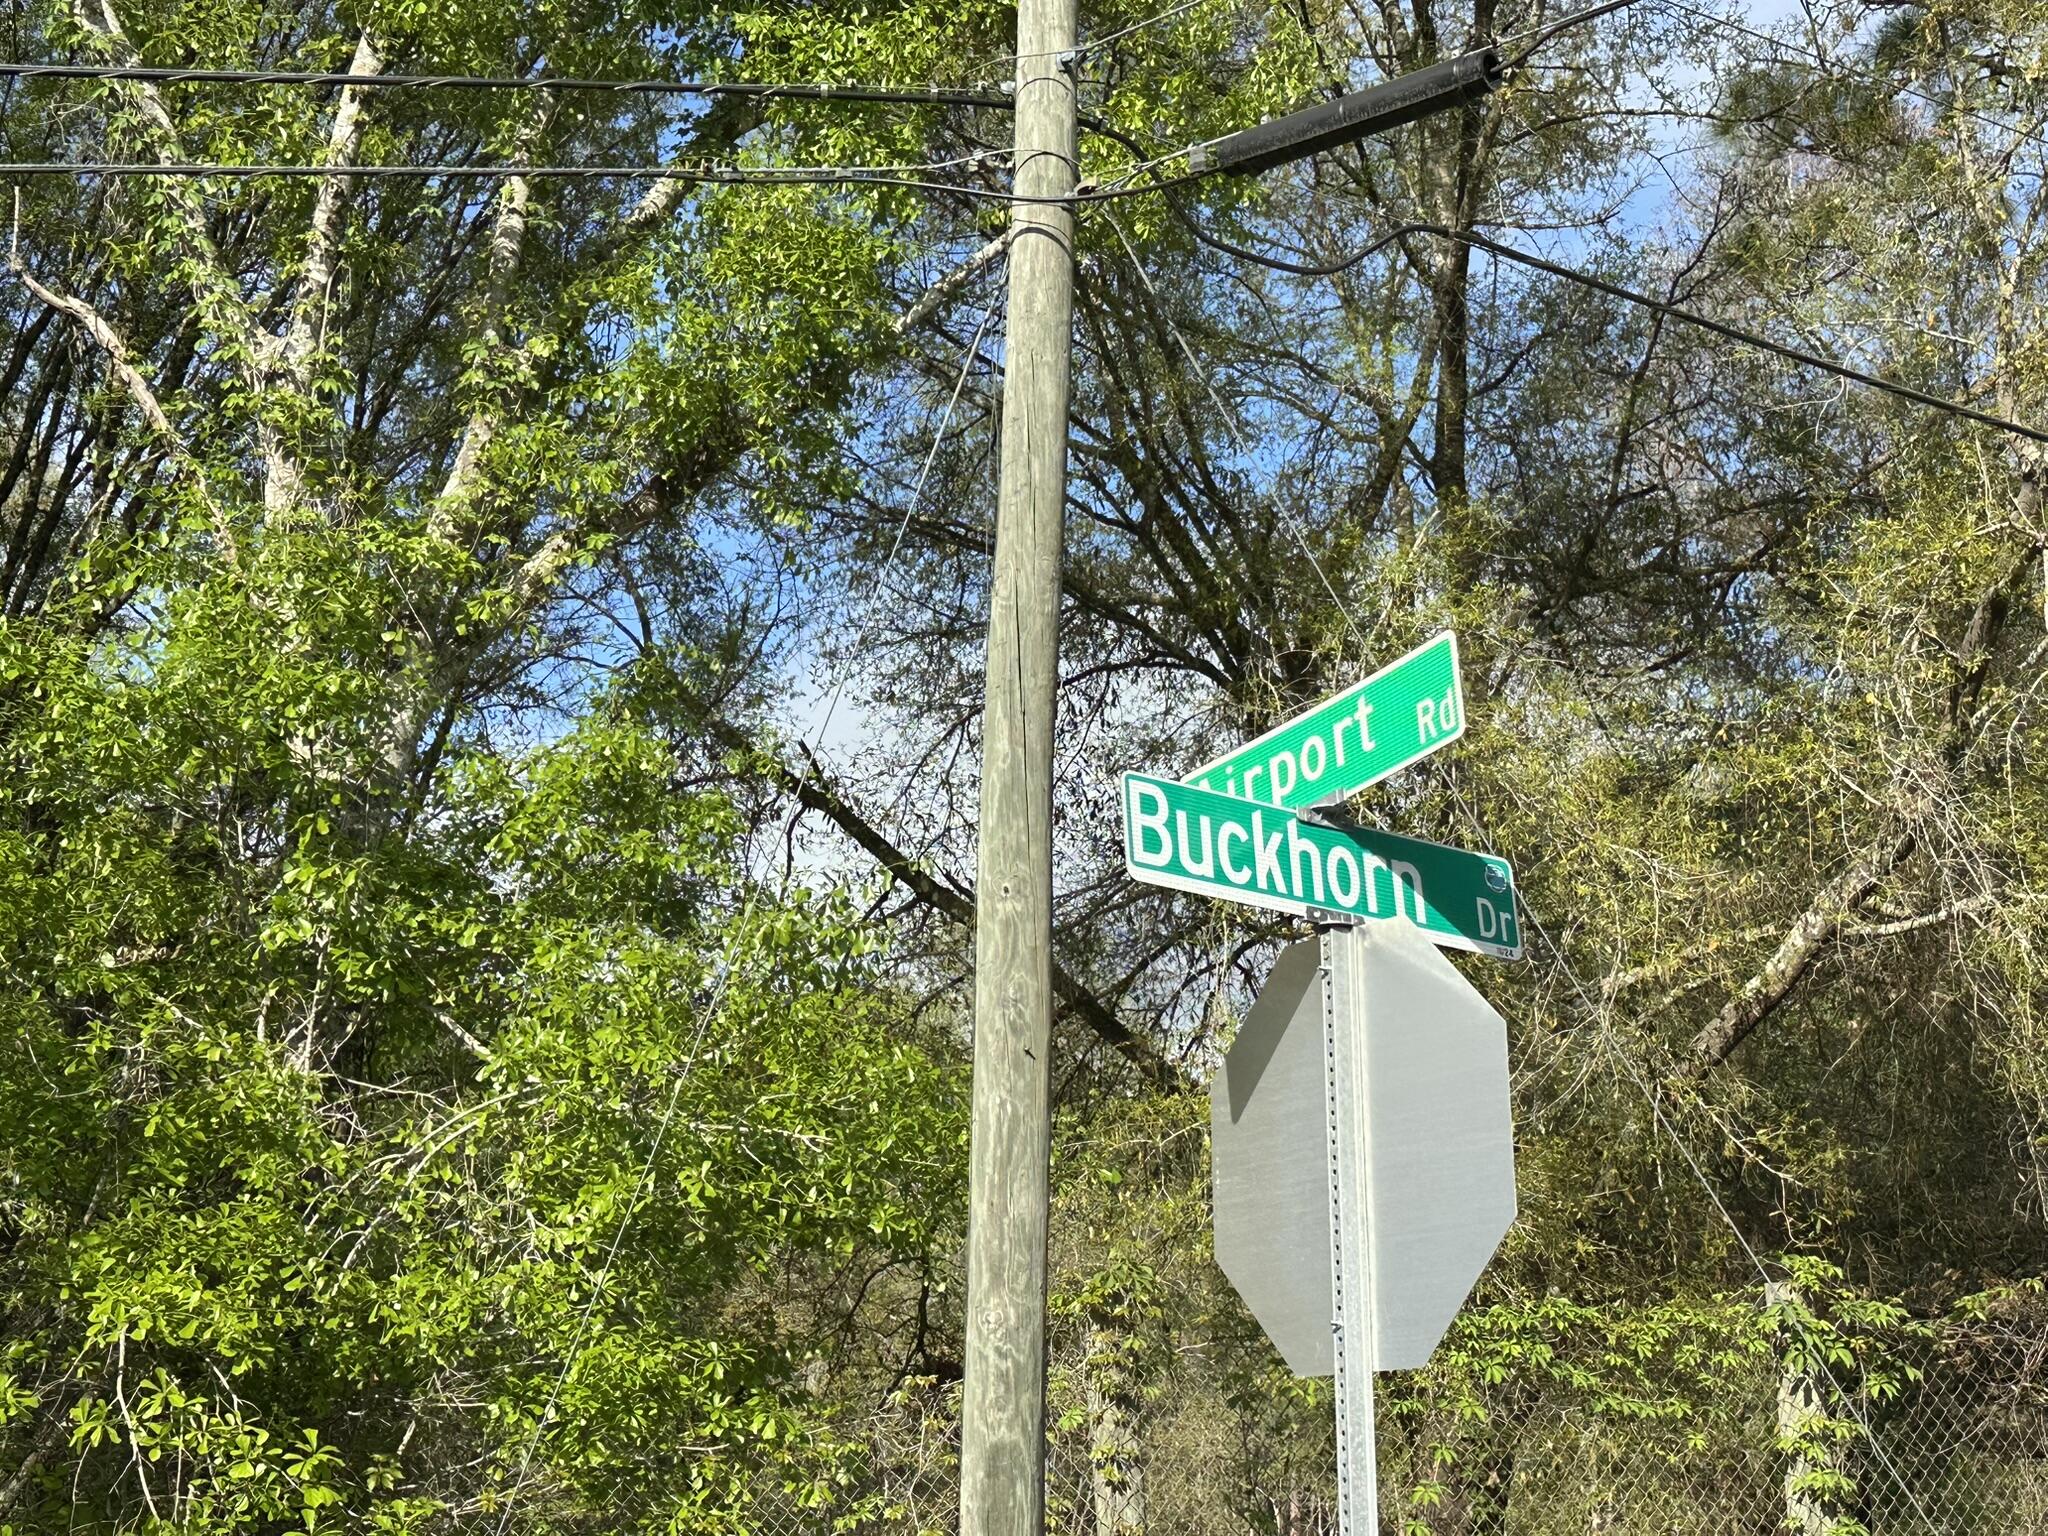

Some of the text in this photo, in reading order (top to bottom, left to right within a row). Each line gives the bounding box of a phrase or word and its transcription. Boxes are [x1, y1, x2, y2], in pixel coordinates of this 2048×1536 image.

[1198, 688, 1456, 806] irport Rd
[1129, 780, 1512, 942] Buckhorn Dr
